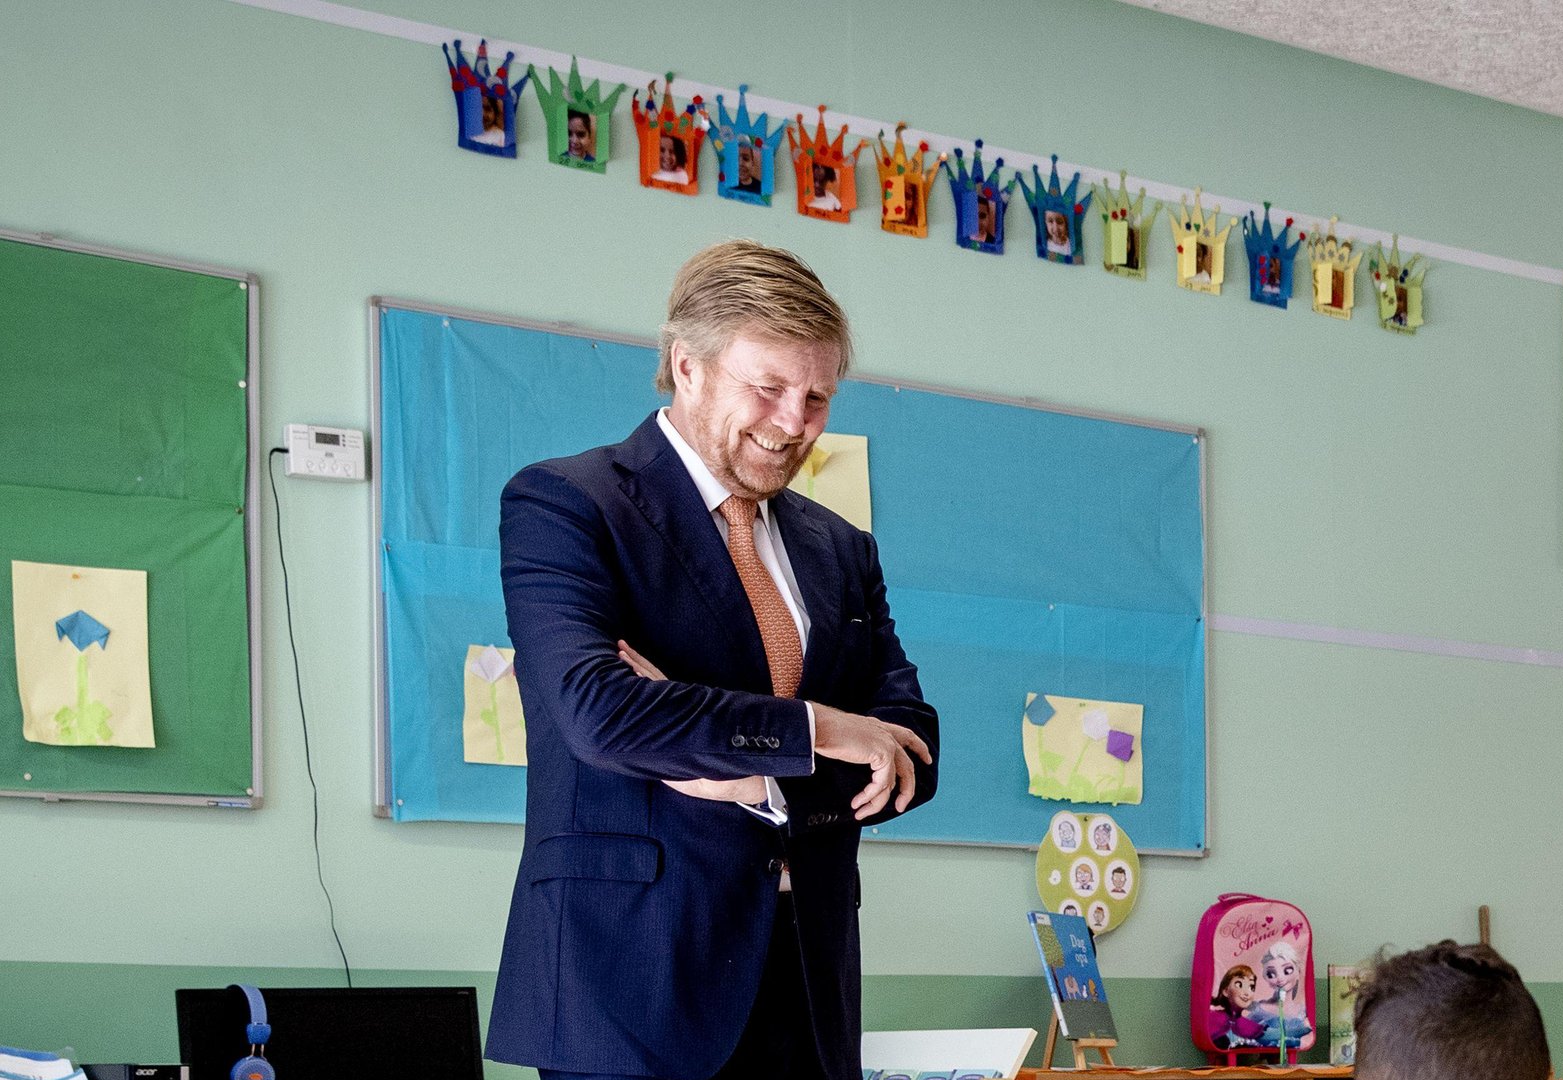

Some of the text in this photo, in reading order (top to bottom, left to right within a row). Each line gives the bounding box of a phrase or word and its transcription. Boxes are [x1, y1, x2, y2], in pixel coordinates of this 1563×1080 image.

[1069, 933, 1088, 953] Dag
[1233, 926, 1279, 957] Anna
[1075, 953, 1089, 968] opa
[135, 1068, 158, 1076] acer
